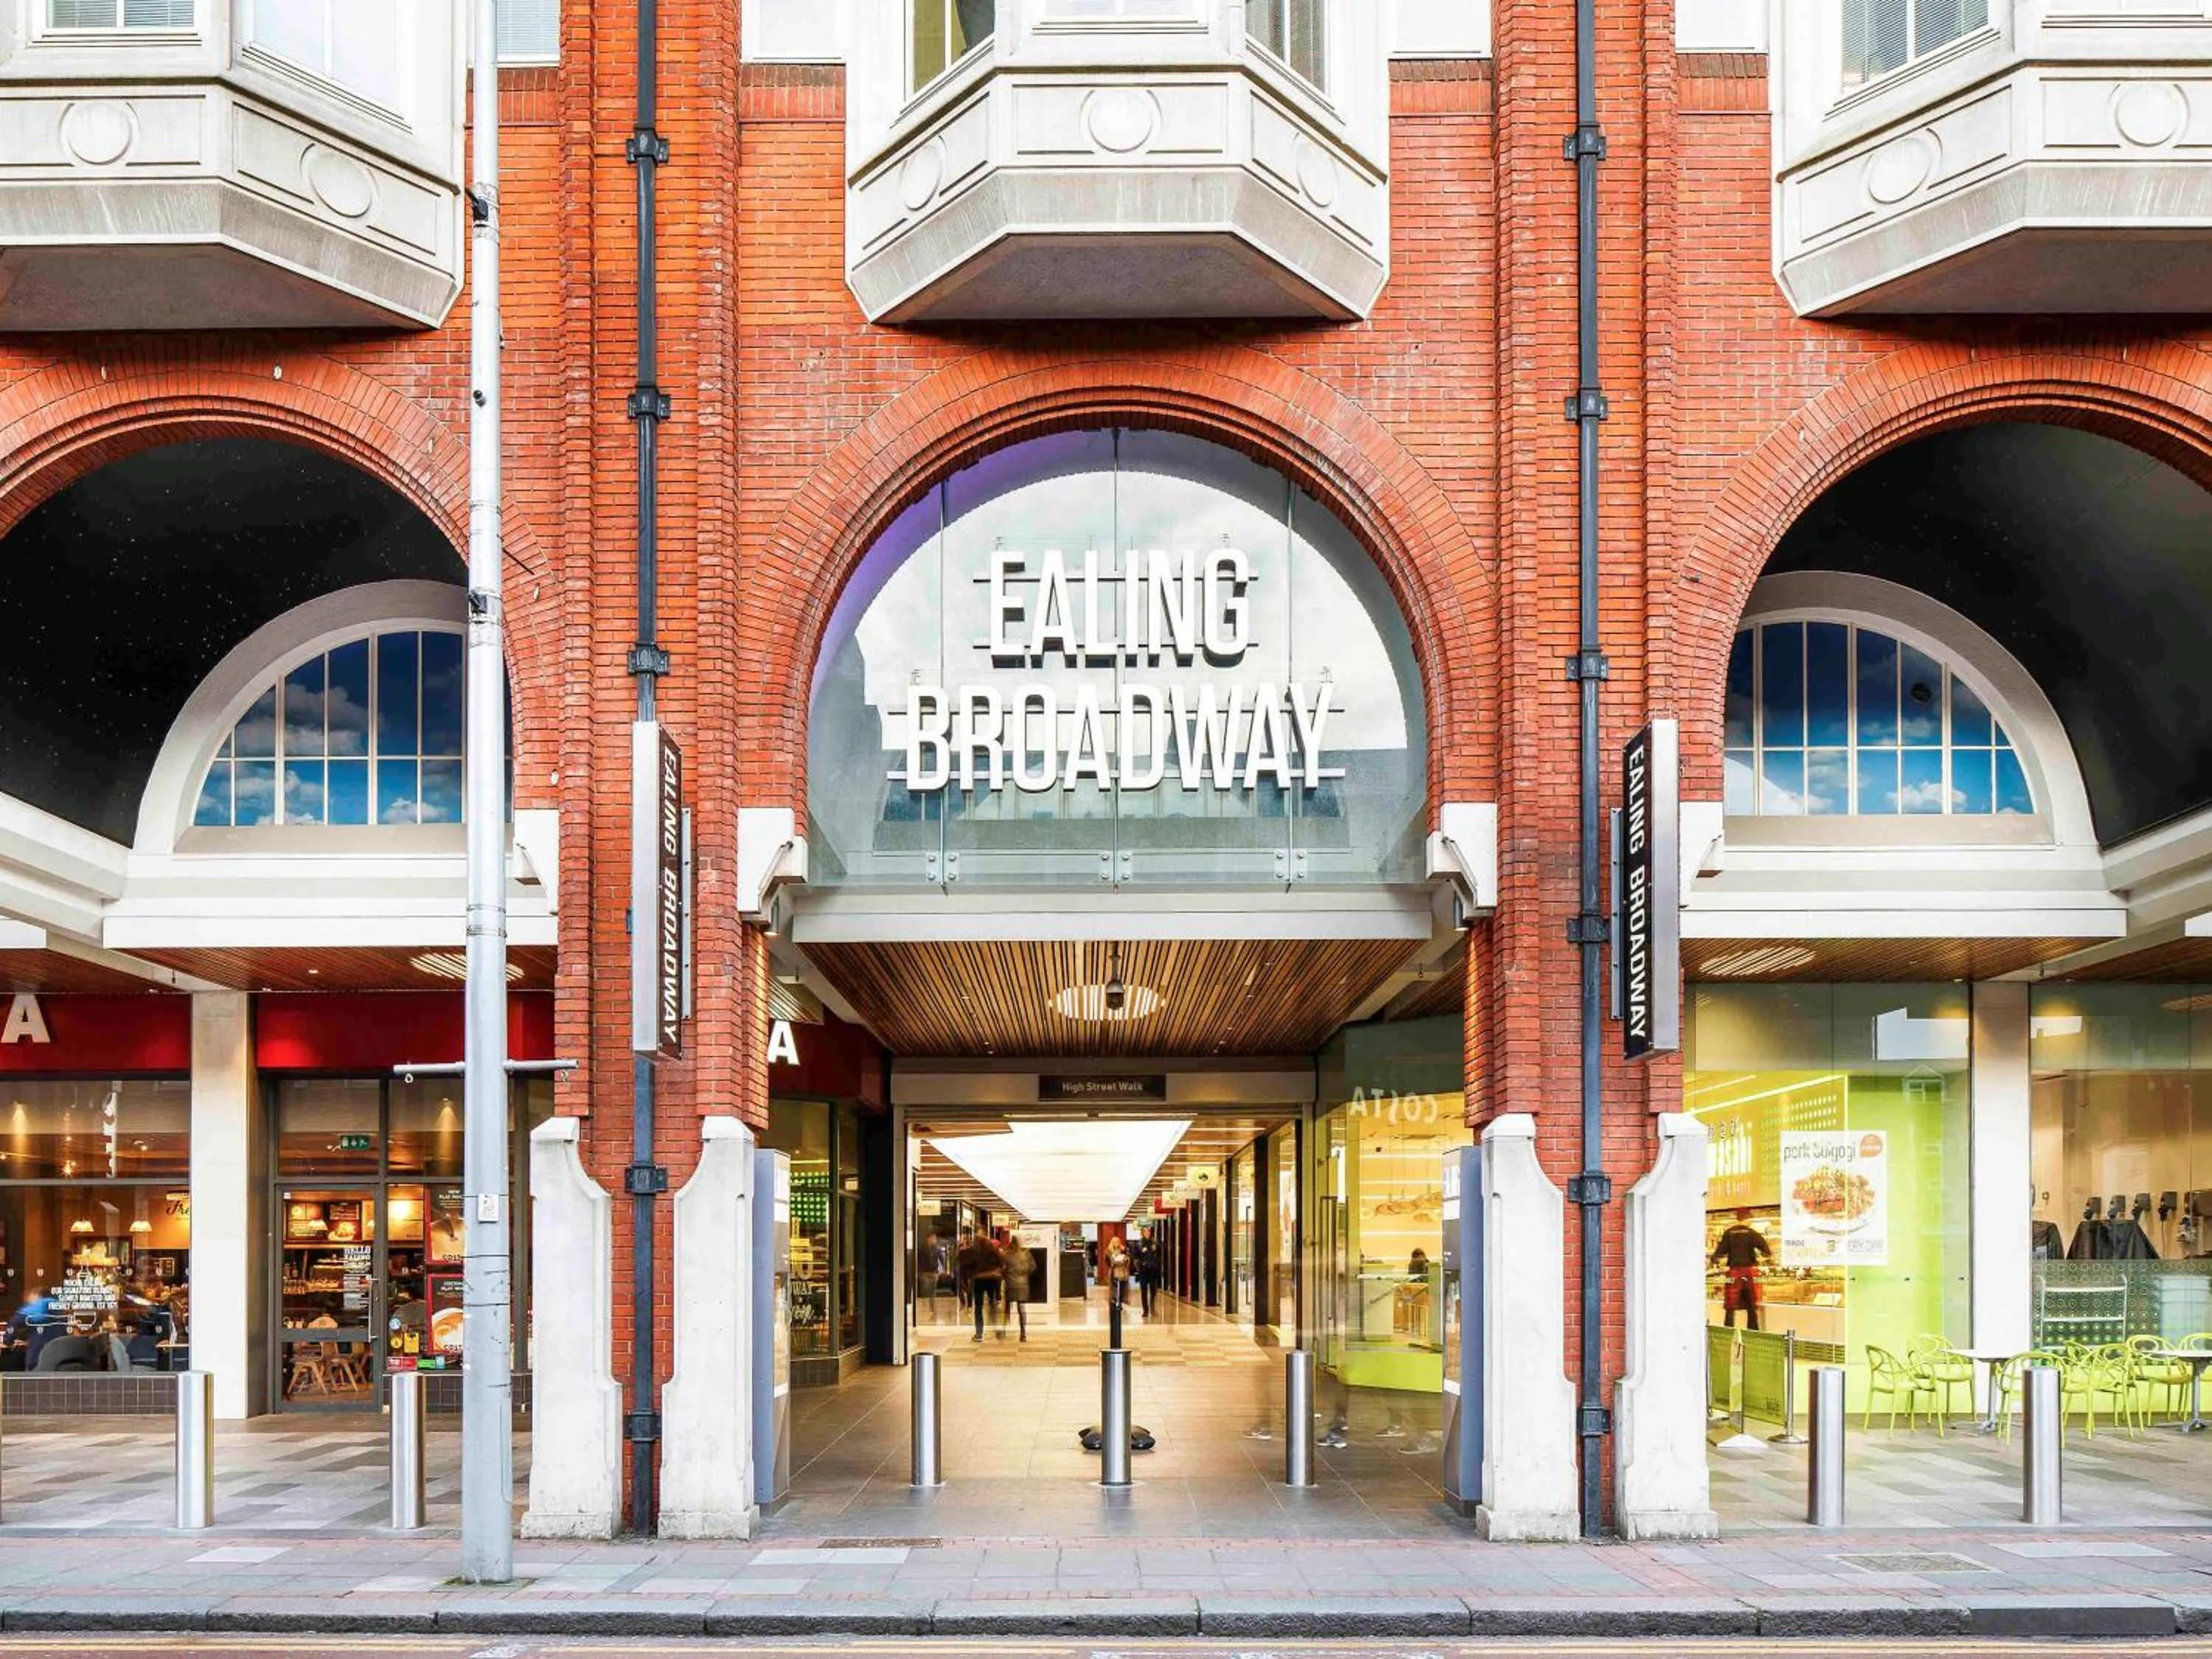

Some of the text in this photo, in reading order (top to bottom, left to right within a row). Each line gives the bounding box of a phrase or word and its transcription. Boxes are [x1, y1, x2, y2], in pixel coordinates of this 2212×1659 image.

[989, 547, 1251, 668] EALING
[905, 683, 1335, 793] BROADWAY
[664, 745, 677, 1043] EALING BROADWAY
[1629, 744, 1646, 1037] EALING BROADWAY
[1062, 1082, 1143, 1093] High Street Walk
